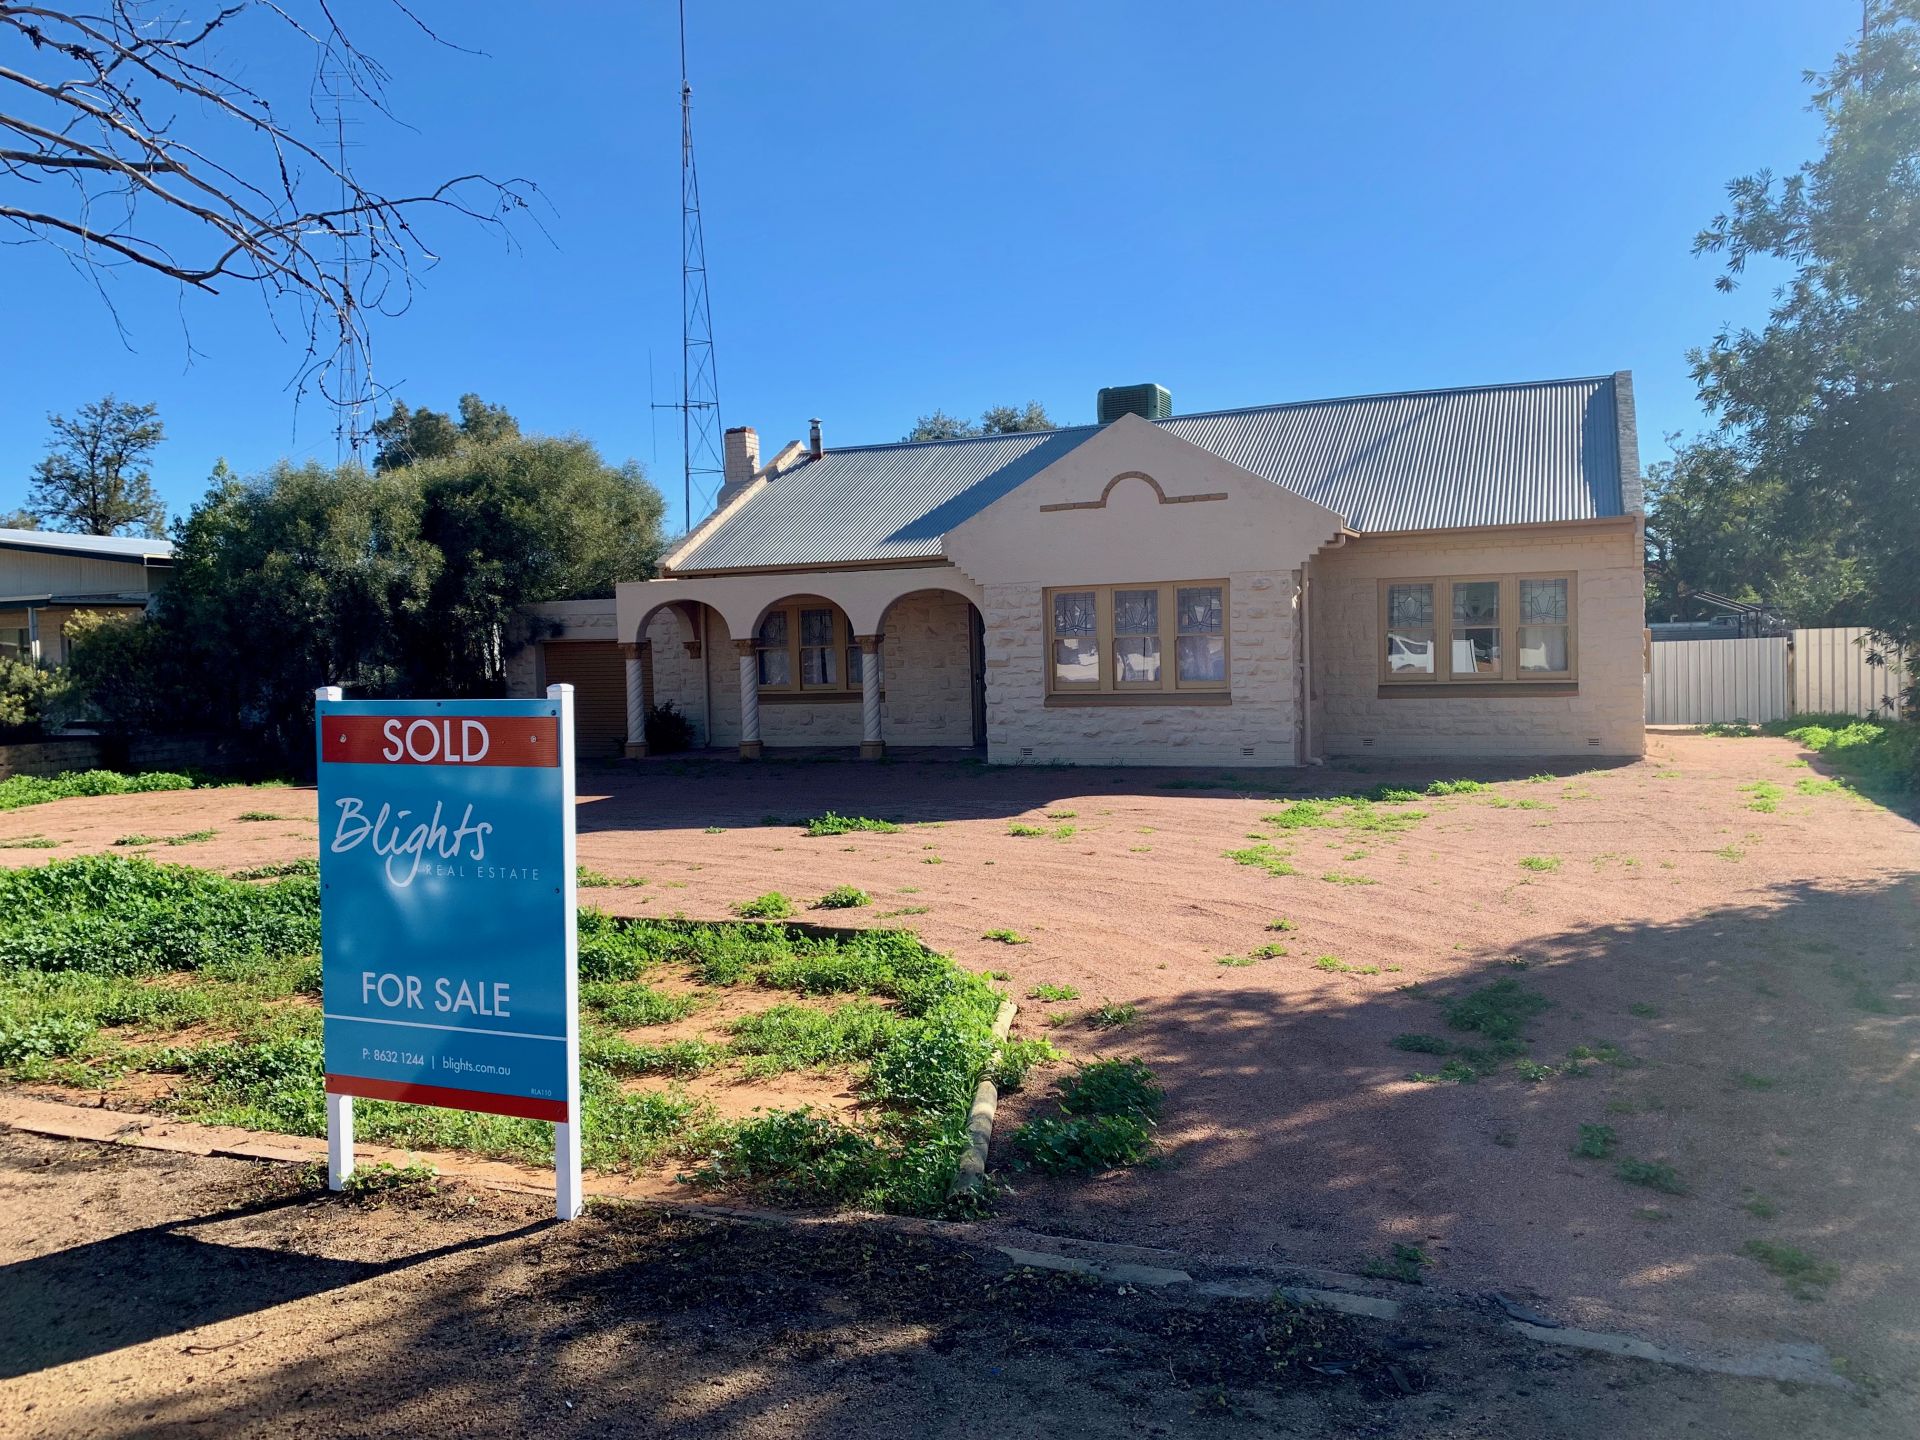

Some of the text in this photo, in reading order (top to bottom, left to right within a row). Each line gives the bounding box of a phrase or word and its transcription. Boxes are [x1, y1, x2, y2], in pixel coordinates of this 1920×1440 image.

[382, 719, 490, 762] SOLD
[331, 798, 493, 888] Blights
[424, 864, 540, 881] REAL ESTATE
[362, 971, 511, 1018] FOR SALE
[362, 1048, 511, 1076] P: 8632 1244 blights.com.au
